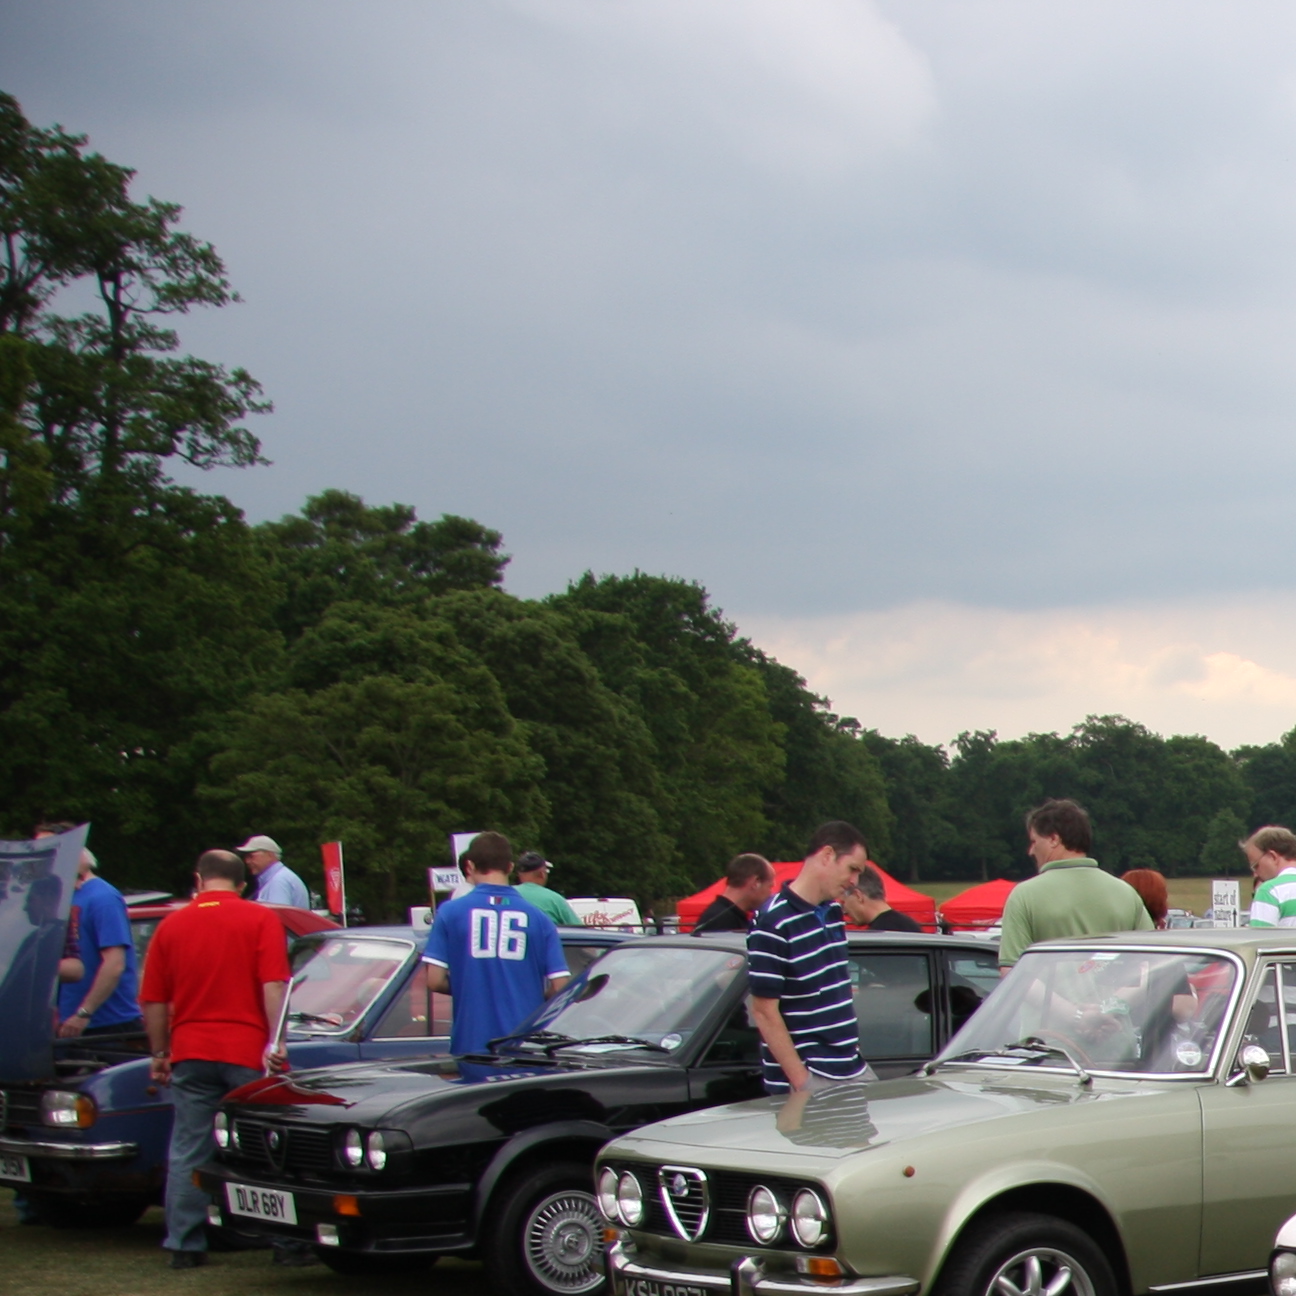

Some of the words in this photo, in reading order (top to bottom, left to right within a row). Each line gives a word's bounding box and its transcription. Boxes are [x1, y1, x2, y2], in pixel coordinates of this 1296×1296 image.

[470, 908, 529, 961] 06
[235, 1188, 261, 1213] DLR
[261, 1192, 285, 1218] 68Y
